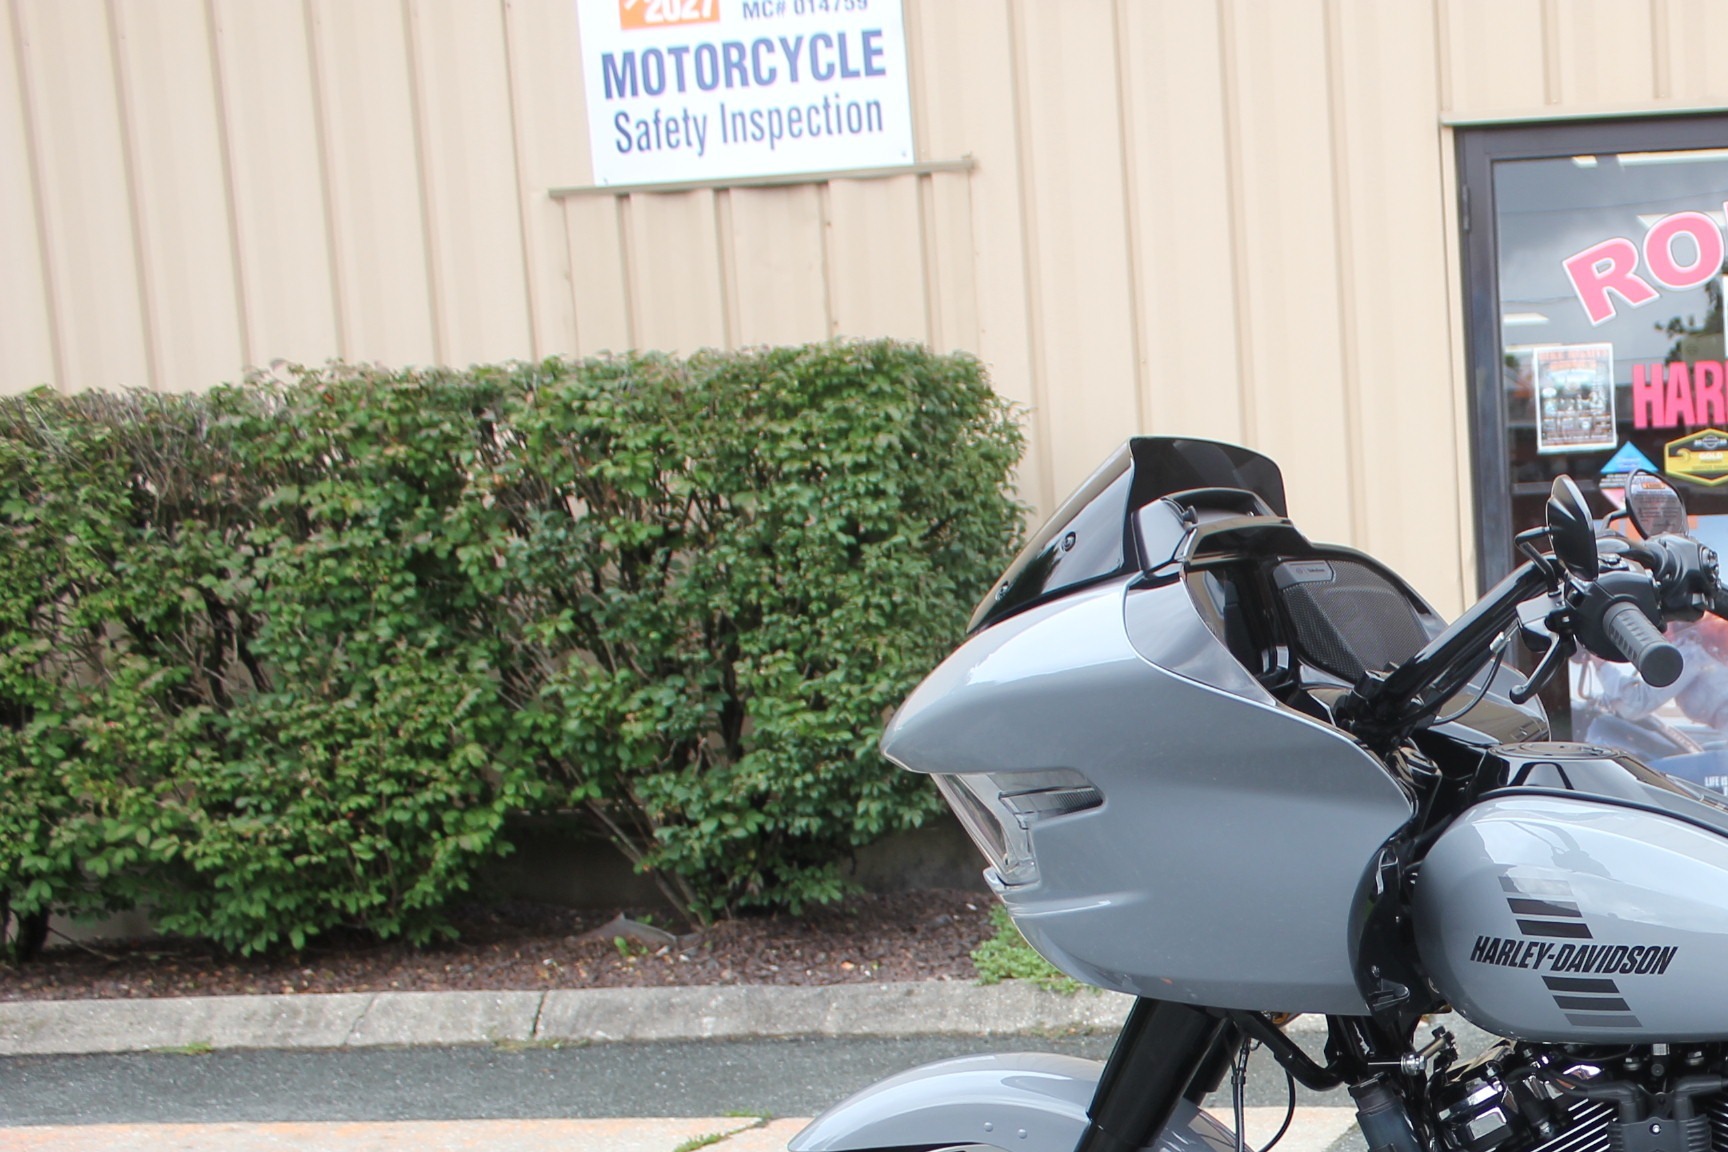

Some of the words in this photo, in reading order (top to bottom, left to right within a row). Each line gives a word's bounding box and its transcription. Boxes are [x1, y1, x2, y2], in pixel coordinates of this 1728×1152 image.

[601, 29, 886, 99] MOTORCYCLE
[613, 105, 708, 157] Safety
[720, 93, 884, 150] Inspection
[1470, 935, 1678, 976] HARLEY-DAVIDSON
